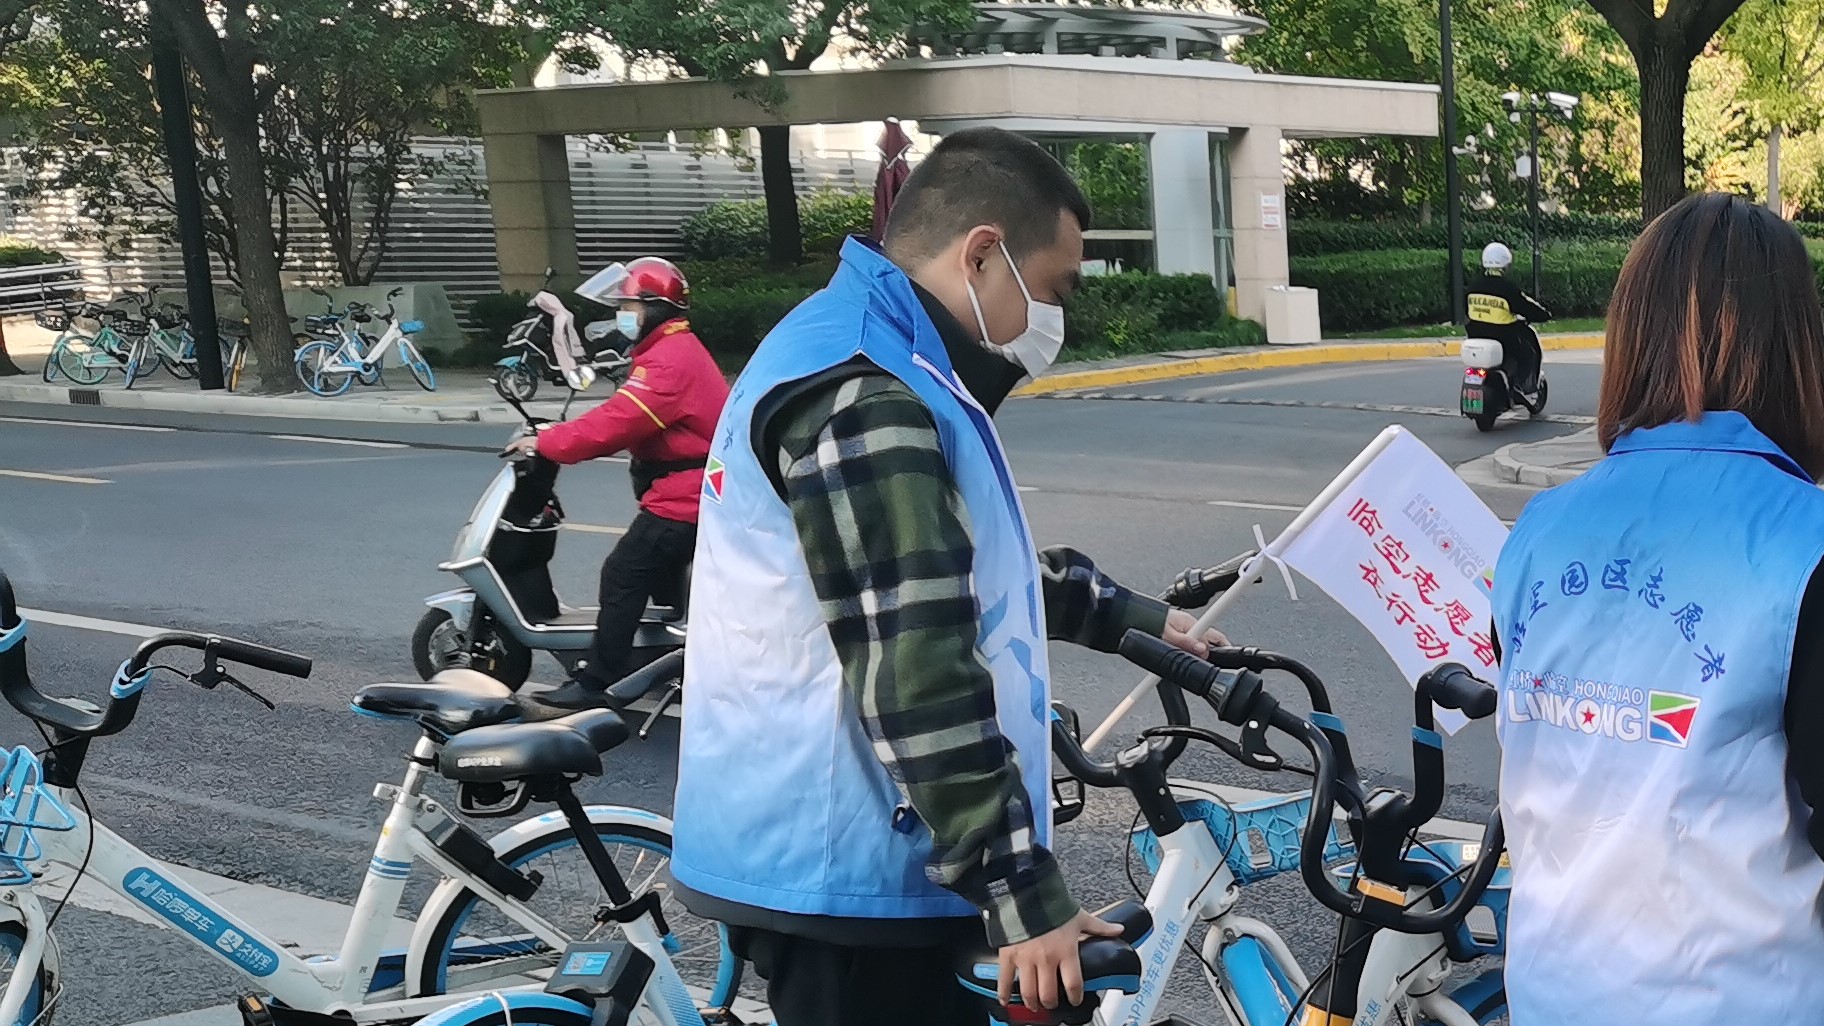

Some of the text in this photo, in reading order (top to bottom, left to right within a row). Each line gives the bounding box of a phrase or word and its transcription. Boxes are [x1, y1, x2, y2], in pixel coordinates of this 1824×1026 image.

[1347, 498, 1495, 667] 临空志愿者
[1359, 558, 1450, 659] 在行动
